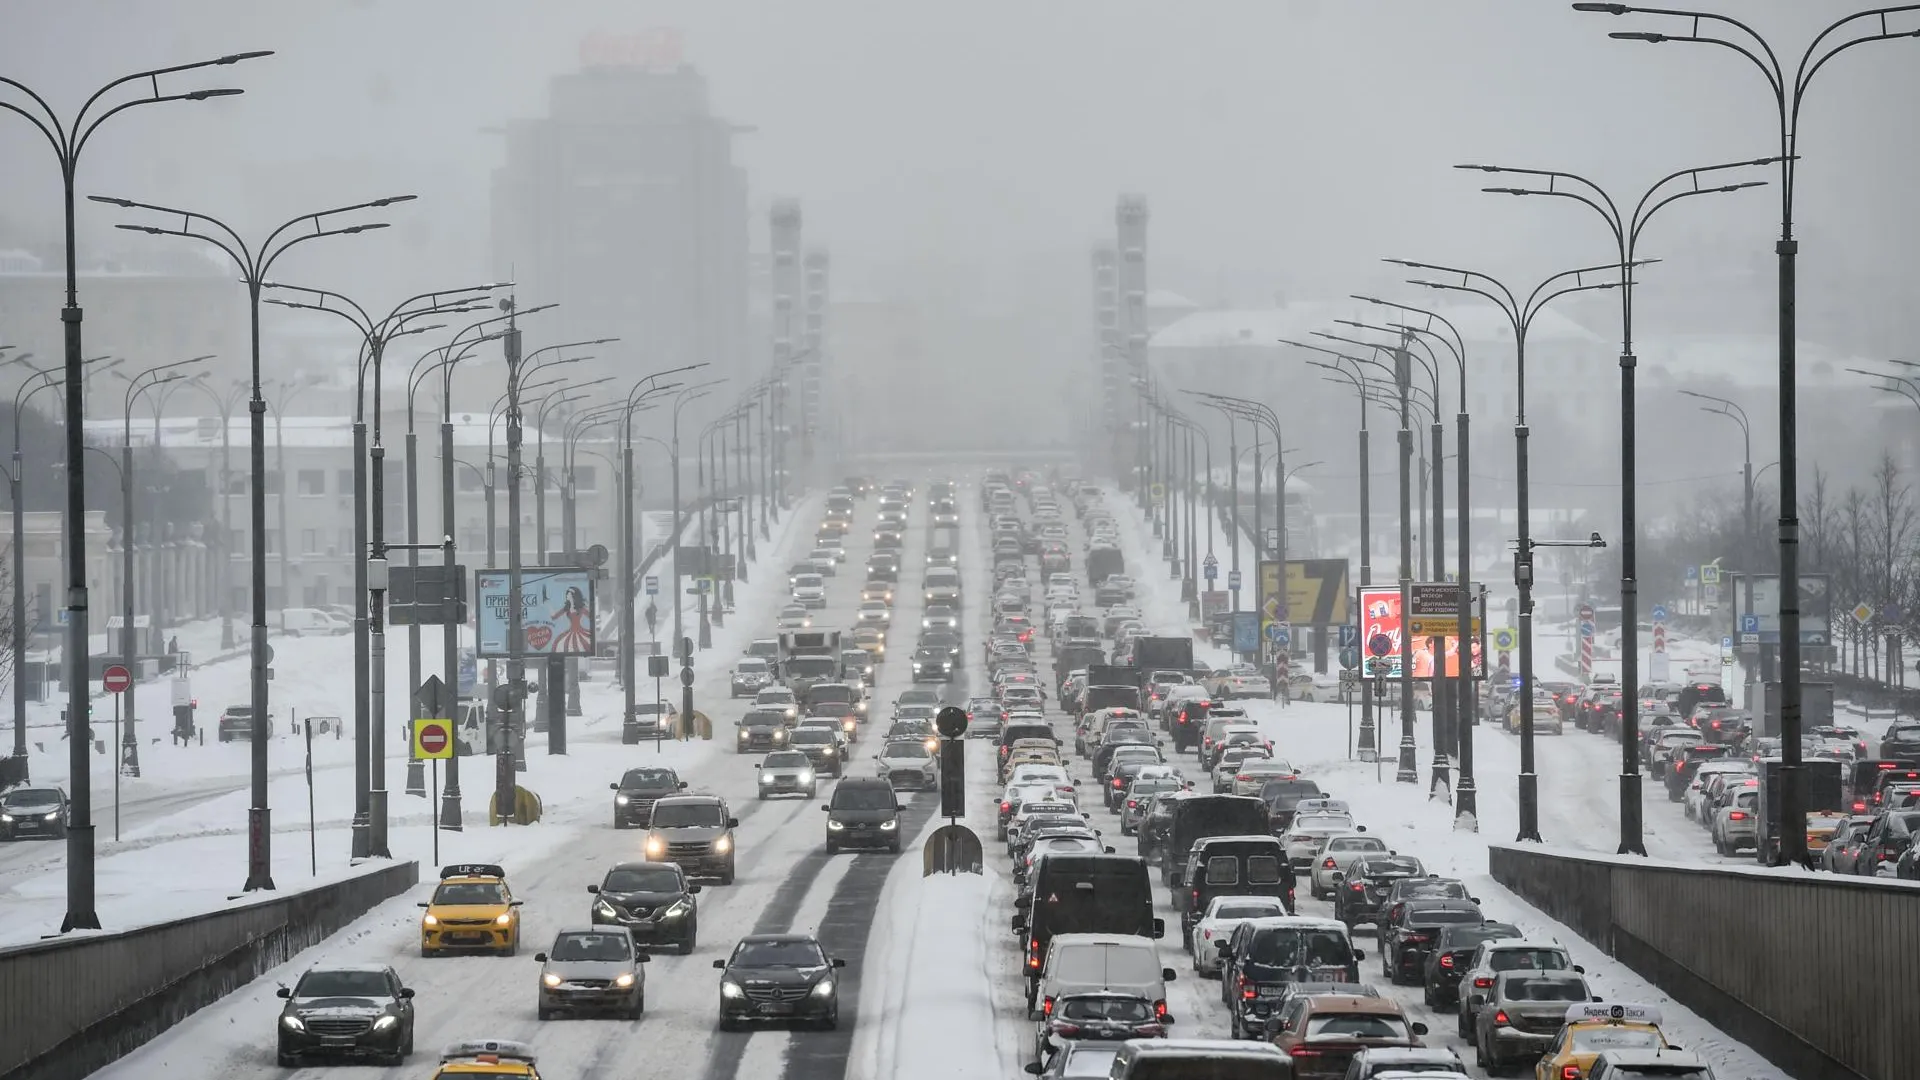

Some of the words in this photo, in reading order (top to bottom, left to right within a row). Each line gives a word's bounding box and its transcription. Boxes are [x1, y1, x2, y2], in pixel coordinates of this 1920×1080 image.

[485, 595, 537, 607] ПРИНССА
[496, 607, 528, 620] ЦИА
[1583, 1006, 1609, 1017] Яндекс
[1612, 1006, 1623, 1017] Go
[1625, 1007, 1645, 1017] Такси
